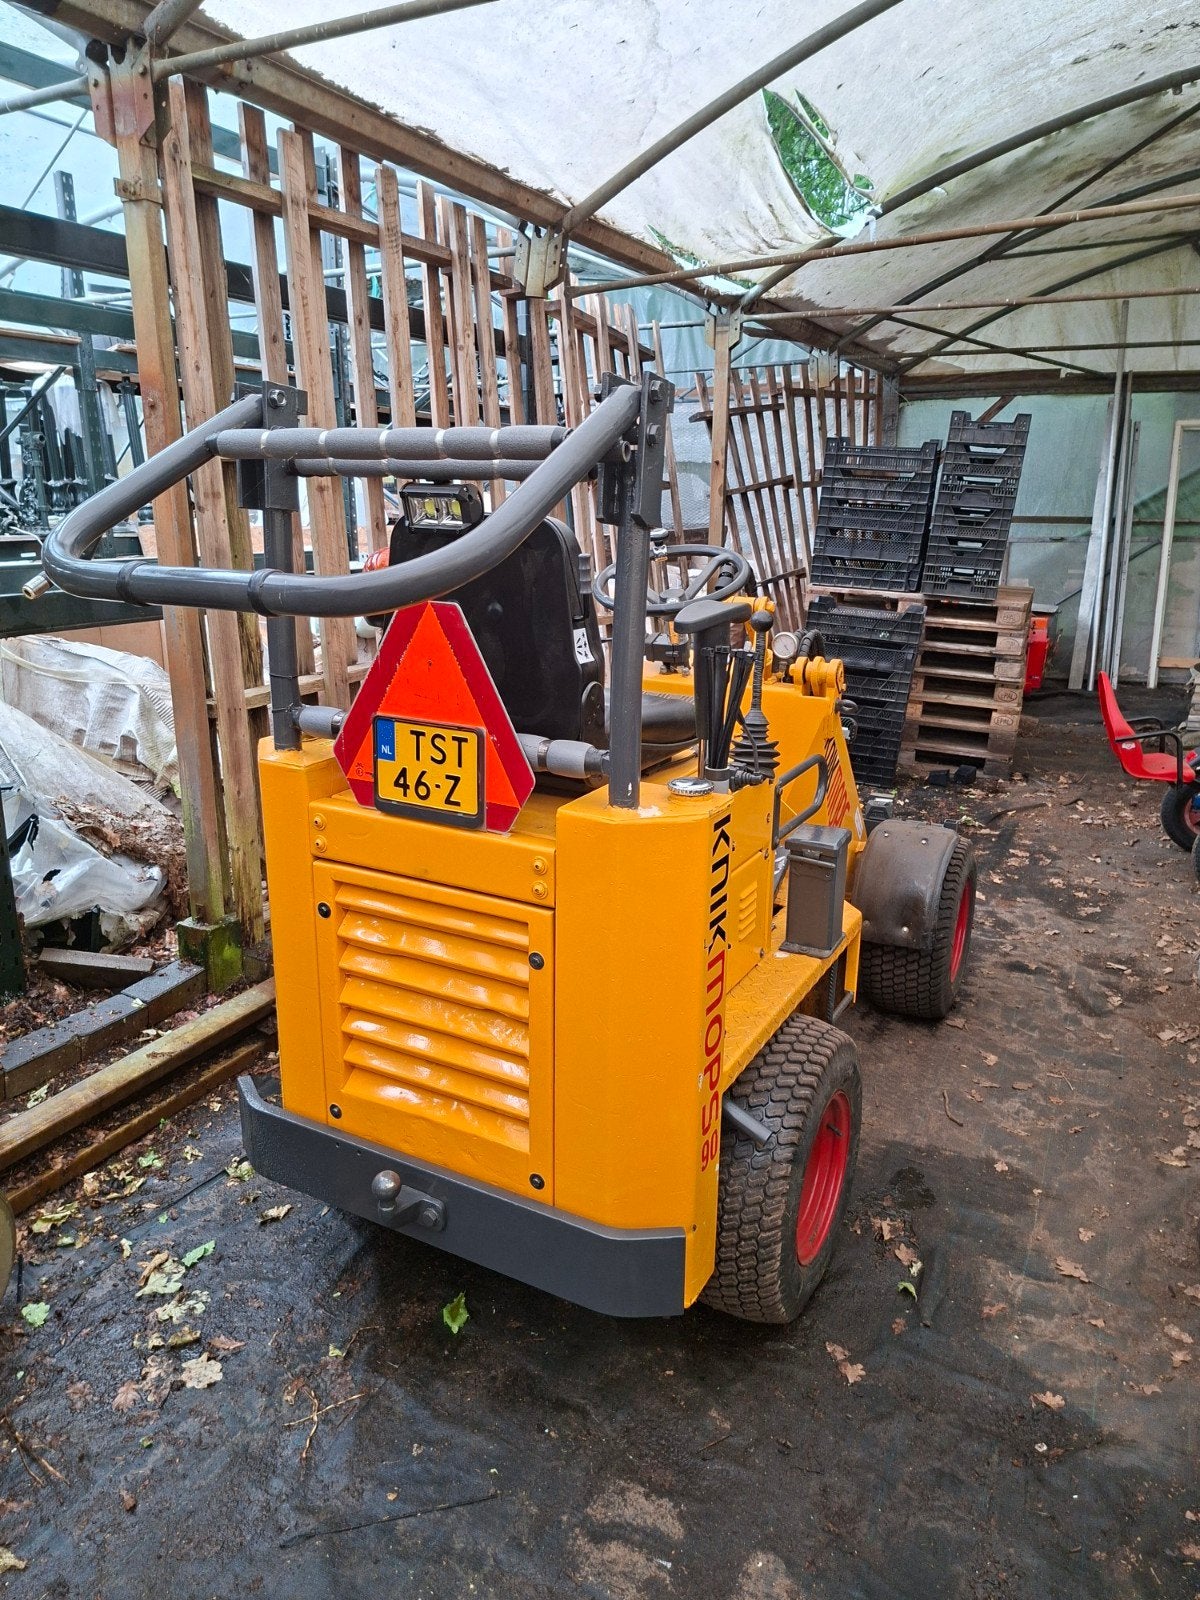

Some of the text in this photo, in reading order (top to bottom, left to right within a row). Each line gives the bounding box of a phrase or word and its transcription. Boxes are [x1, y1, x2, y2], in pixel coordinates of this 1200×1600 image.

[381, 745, 393, 755] NL
[409, 730, 469, 768] TST
[393, 766, 461, 807] 46-Z
[701, 1129, 719, 1172] 90
